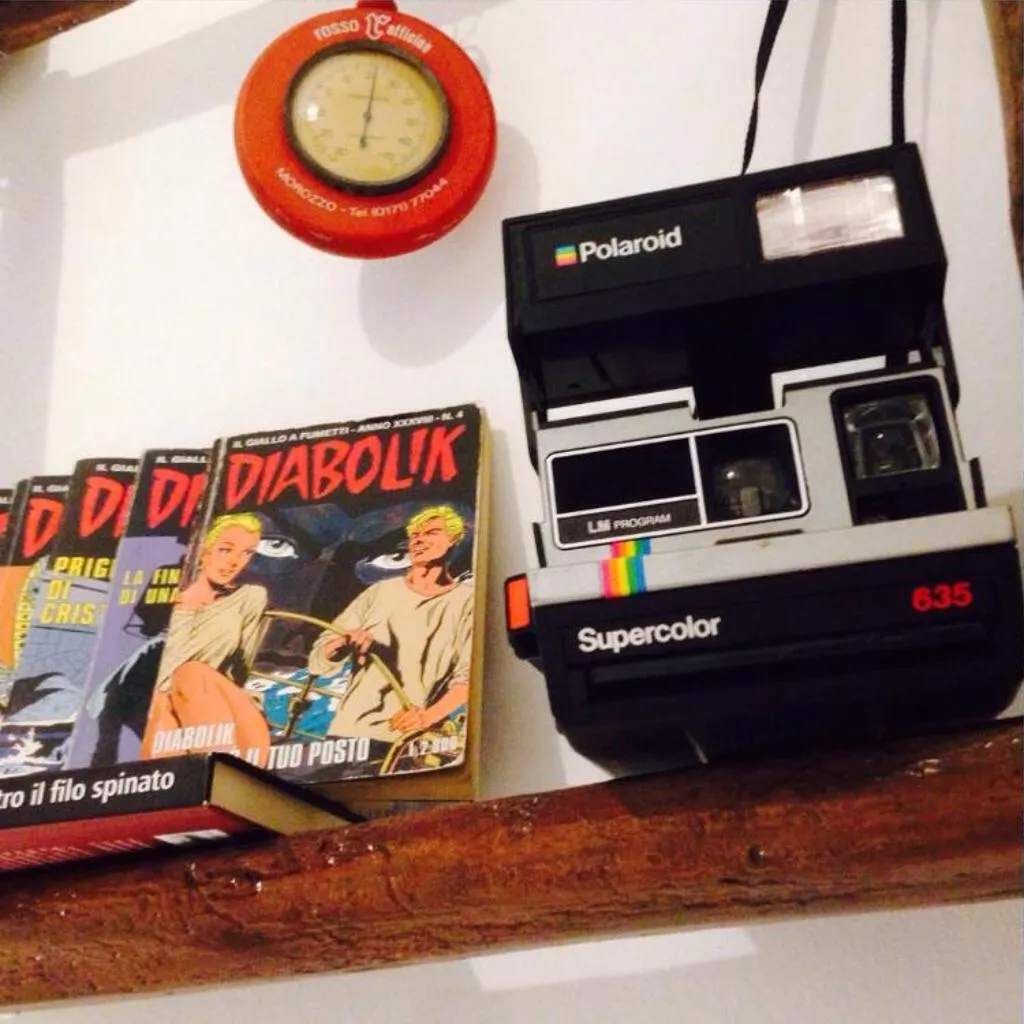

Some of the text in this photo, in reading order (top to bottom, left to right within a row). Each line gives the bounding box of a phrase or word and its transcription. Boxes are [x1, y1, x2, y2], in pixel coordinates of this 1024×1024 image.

[276, 167, 337, 212] MOROZZO
[579, 226, 682, 263] Polaroid
[245, 434, 288, 447] GIALLO
[288, 432, 297, 442] A
[299, 427, 349, 441] FUMETTI
[357, 421, 389, 433] ANNO
[225, 424, 466, 511] DIABOLIK
[614, 513, 672, 529] PROGRAM
[577, 581, 974, 653] Supercolor 635
[152, 721, 236, 756] DIABOLIK
[267, 742, 306, 770] TUO
[308, 738, 370, 766] POSTO
[30, 781, 46, 806] il
[49, 778, 85, 803] filo
[91, 769, 175, 804] spinato
